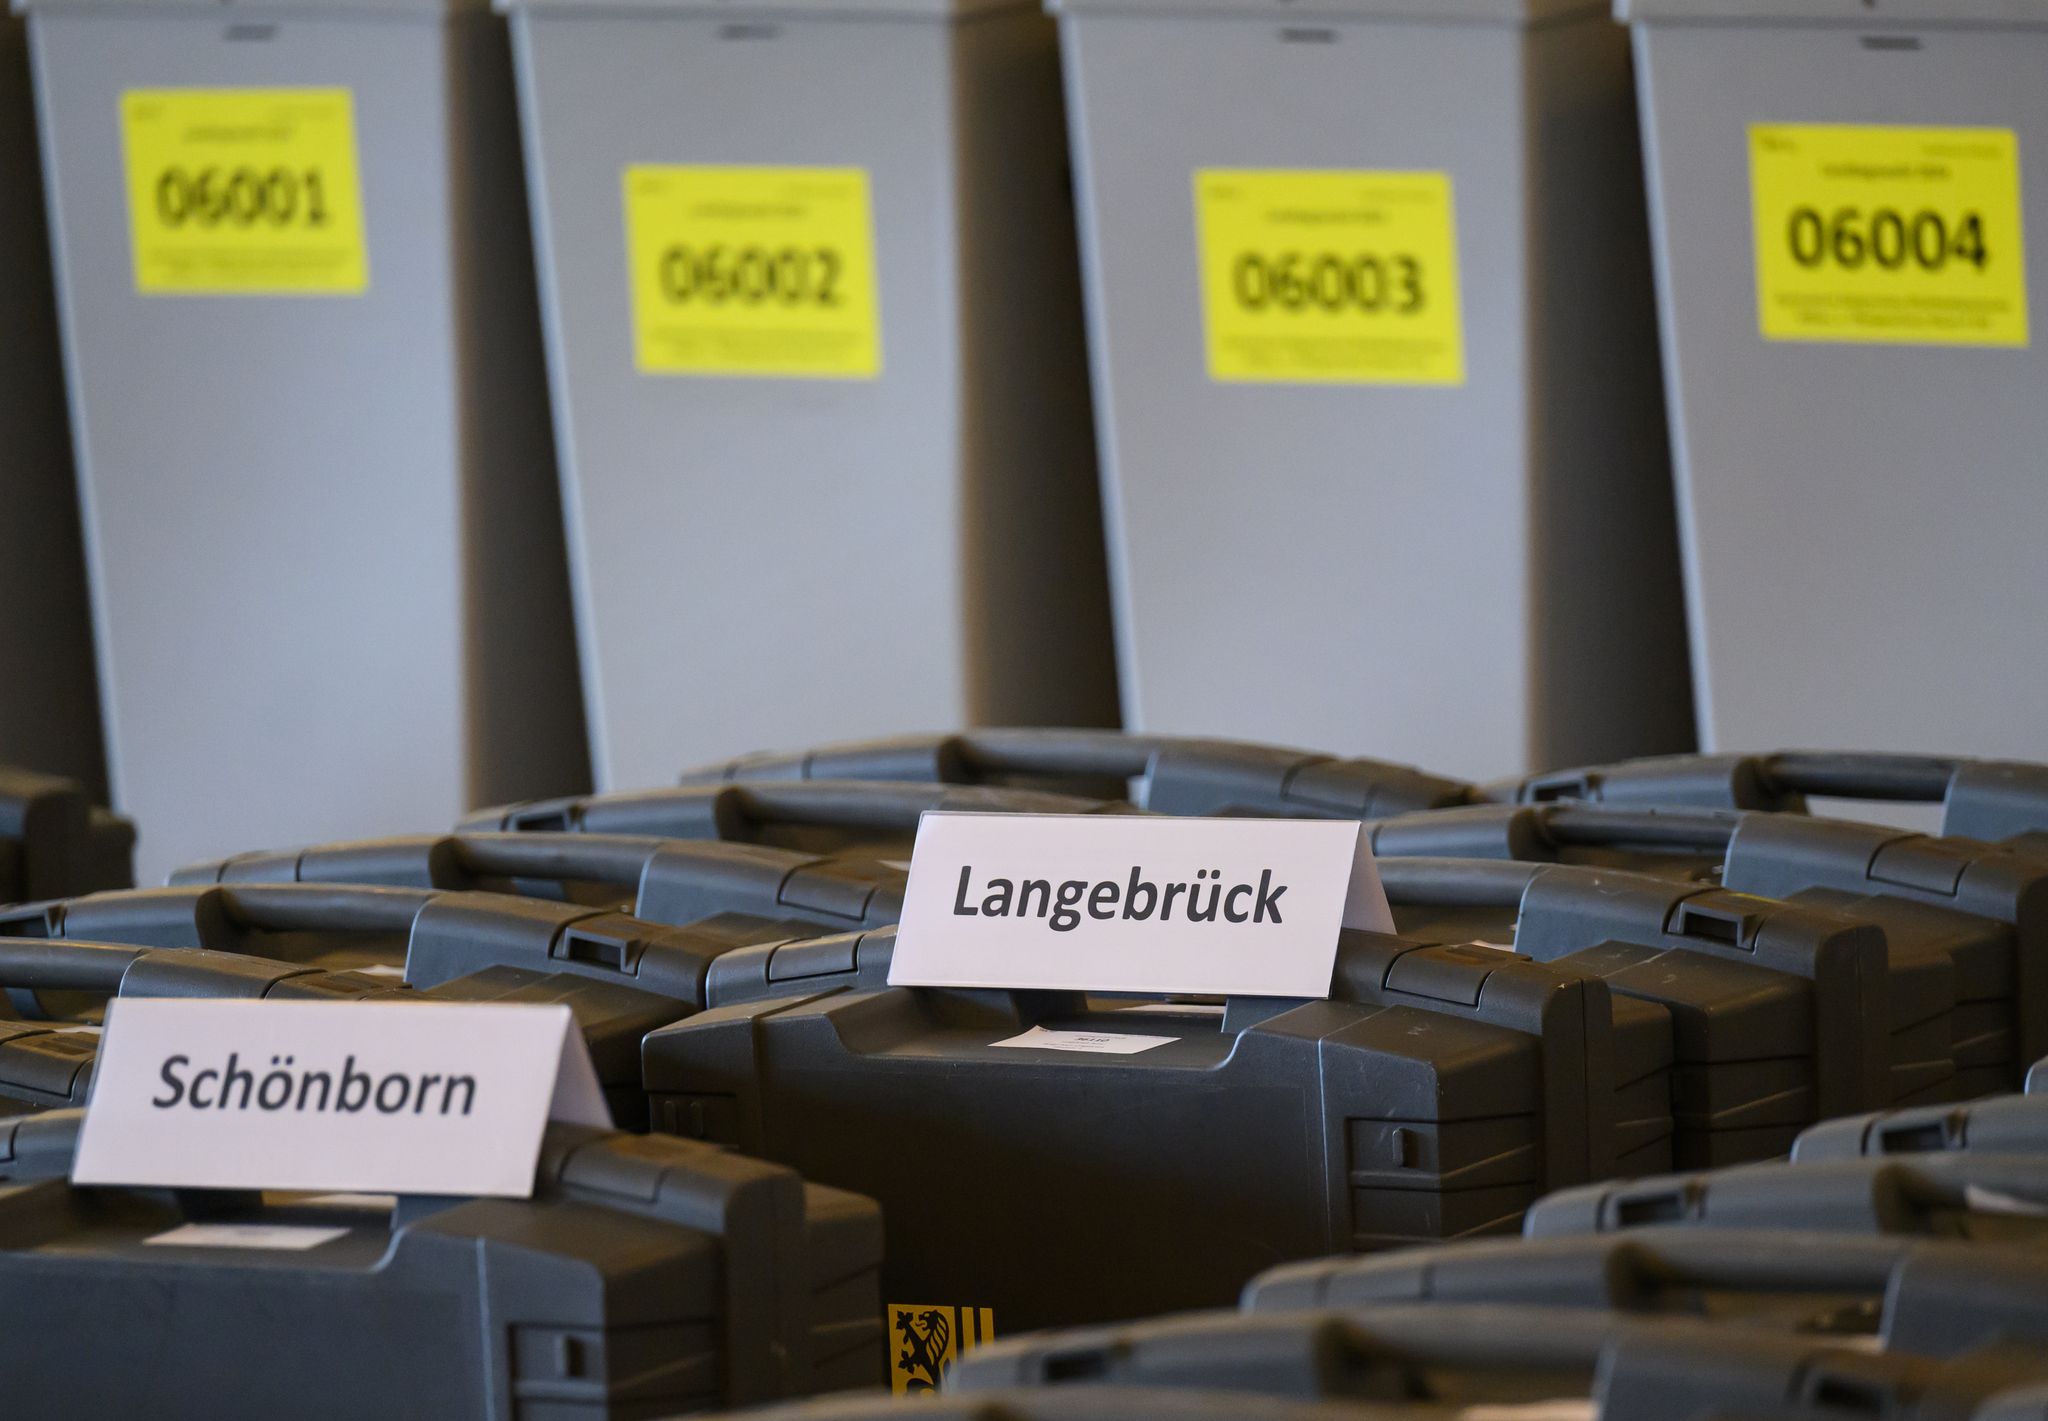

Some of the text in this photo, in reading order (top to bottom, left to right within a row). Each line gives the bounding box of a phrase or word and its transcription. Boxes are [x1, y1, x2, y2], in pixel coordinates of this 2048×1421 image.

[156, 166, 328, 230] 06001
[1788, 207, 1987, 272] 06004
[659, 245, 842, 307] 06002
[1233, 251, 1424, 314] 06003
[953, 865, 1288, 932] Langebrück
[153, 1053, 475, 1116] Schönborn
